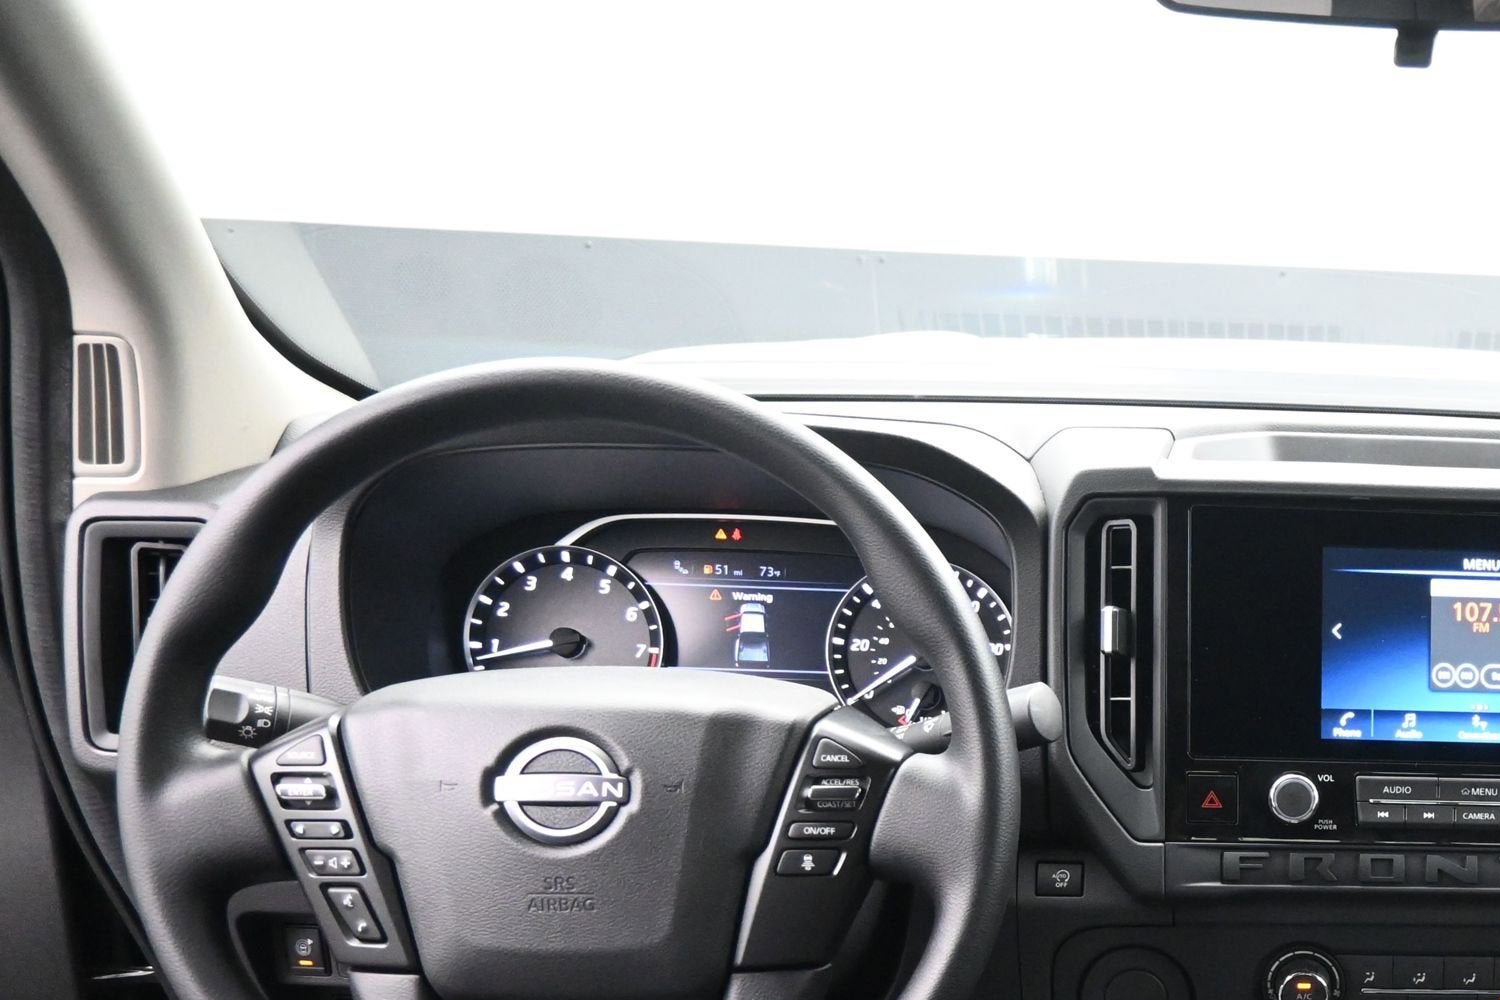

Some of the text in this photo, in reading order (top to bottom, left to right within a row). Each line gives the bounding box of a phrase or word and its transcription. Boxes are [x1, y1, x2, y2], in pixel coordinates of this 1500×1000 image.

[714, 564, 729, 575] 51
[1463, 558, 1500, 572] MENU
[560, 566, 574, 581] 4
[524, 575, 537, 591] 3
[598, 579, 612, 594] 5
[731, 591, 774, 604] Warning
[496, 601, 510, 617] 2
[625, 606, 638, 622] 6
[1472, 622, 1490, 633] FM
[491, 638, 500, 653] 1
[850, 638, 871, 651] 20
[878, 637, 890, 645] 40
[635, 643, 647, 658] 7
[877, 657, 888, 665] 20
[820, 754, 850, 763] CANCEL
[821, 778, 860, 786] ACCEL/RES
[1317, 774, 1335, 782] VOL
[1382, 786, 1412, 794] AUDIO
[1471, 787, 1498, 797] MENU
[1462, 812, 1496, 821] CAMERA
[803, 826, 836, 835] ON/OFF
[543, 876, 577, 891] SRS
[527, 897, 595, 913] AIRBAG
